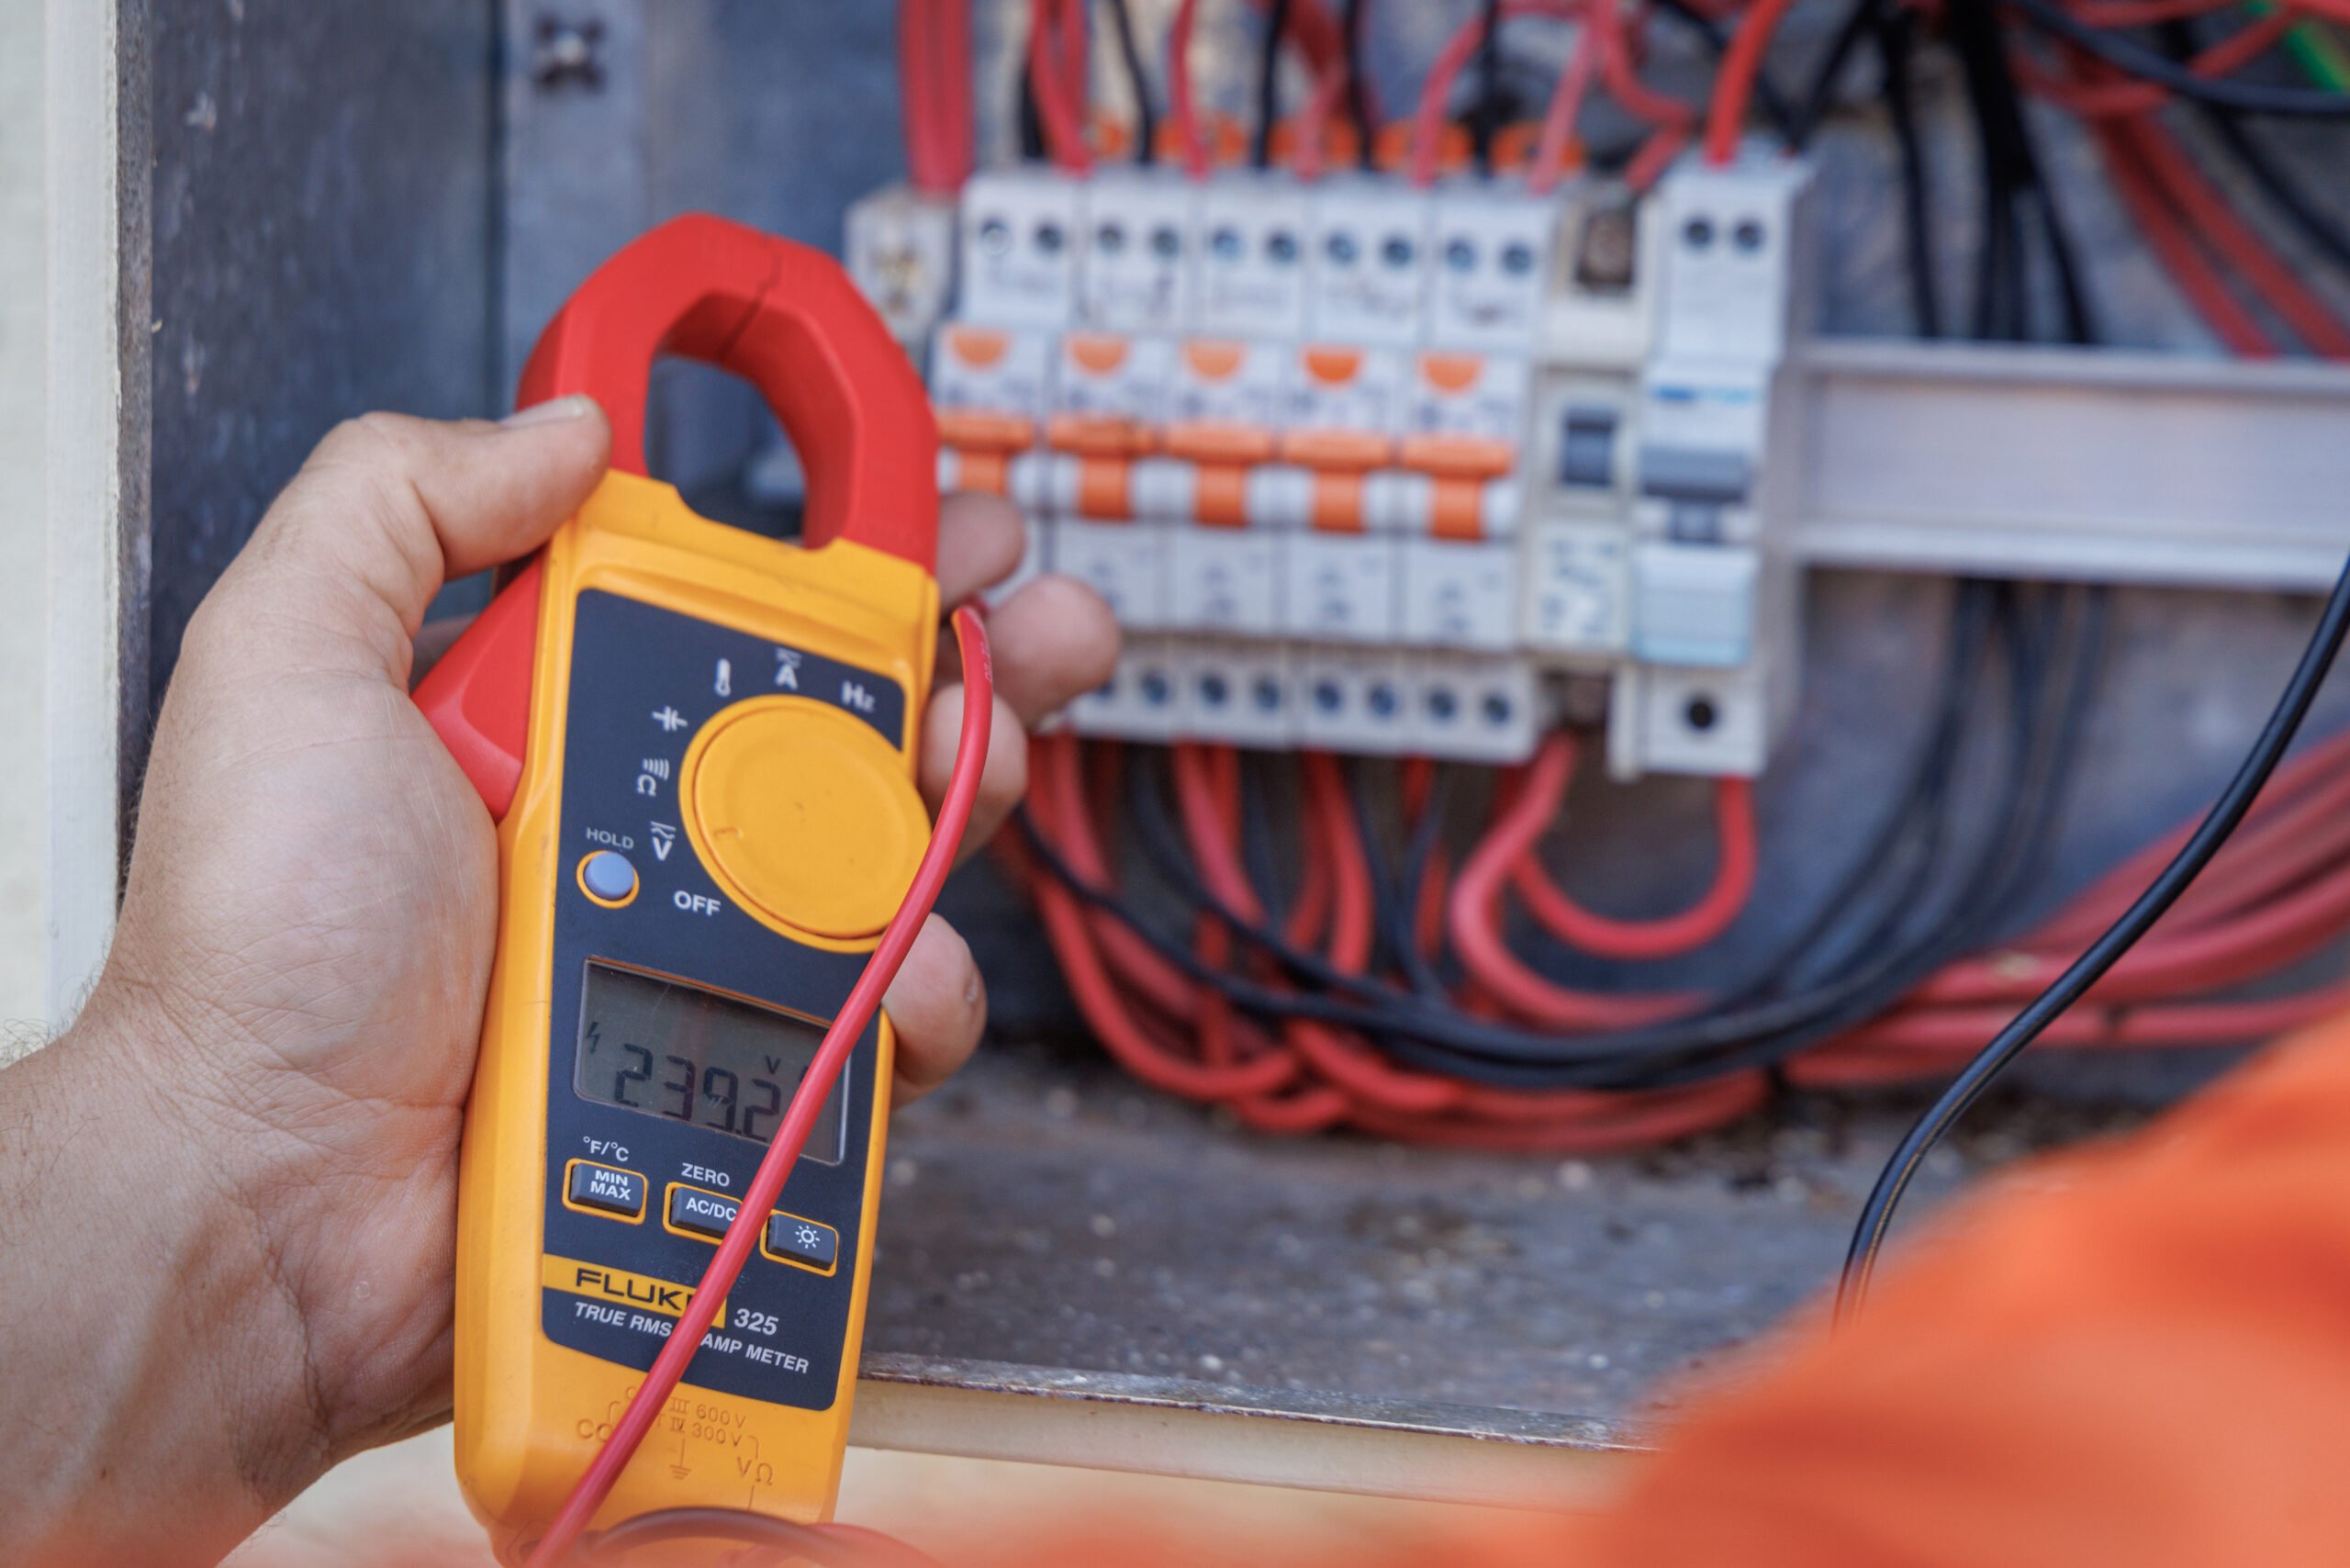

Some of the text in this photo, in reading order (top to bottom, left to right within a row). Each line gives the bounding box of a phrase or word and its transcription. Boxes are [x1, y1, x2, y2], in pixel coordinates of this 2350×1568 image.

[842, 681, 876, 712] Hz
[586, 827, 634, 850] HOLD
[674, 890, 722, 916] OFF
[594, 1170, 629, 1187] MIN
[681, 1162, 731, 1187] ZERO
[590, 1181, 632, 1201] MAX
[686, 1197, 737, 1222] AC/DC
[576, 1267, 779, 1336] FLUK 325
[575, 1302, 810, 1374] TRUE RMS AMP METER
[576, 1418, 613, 1444] CO
